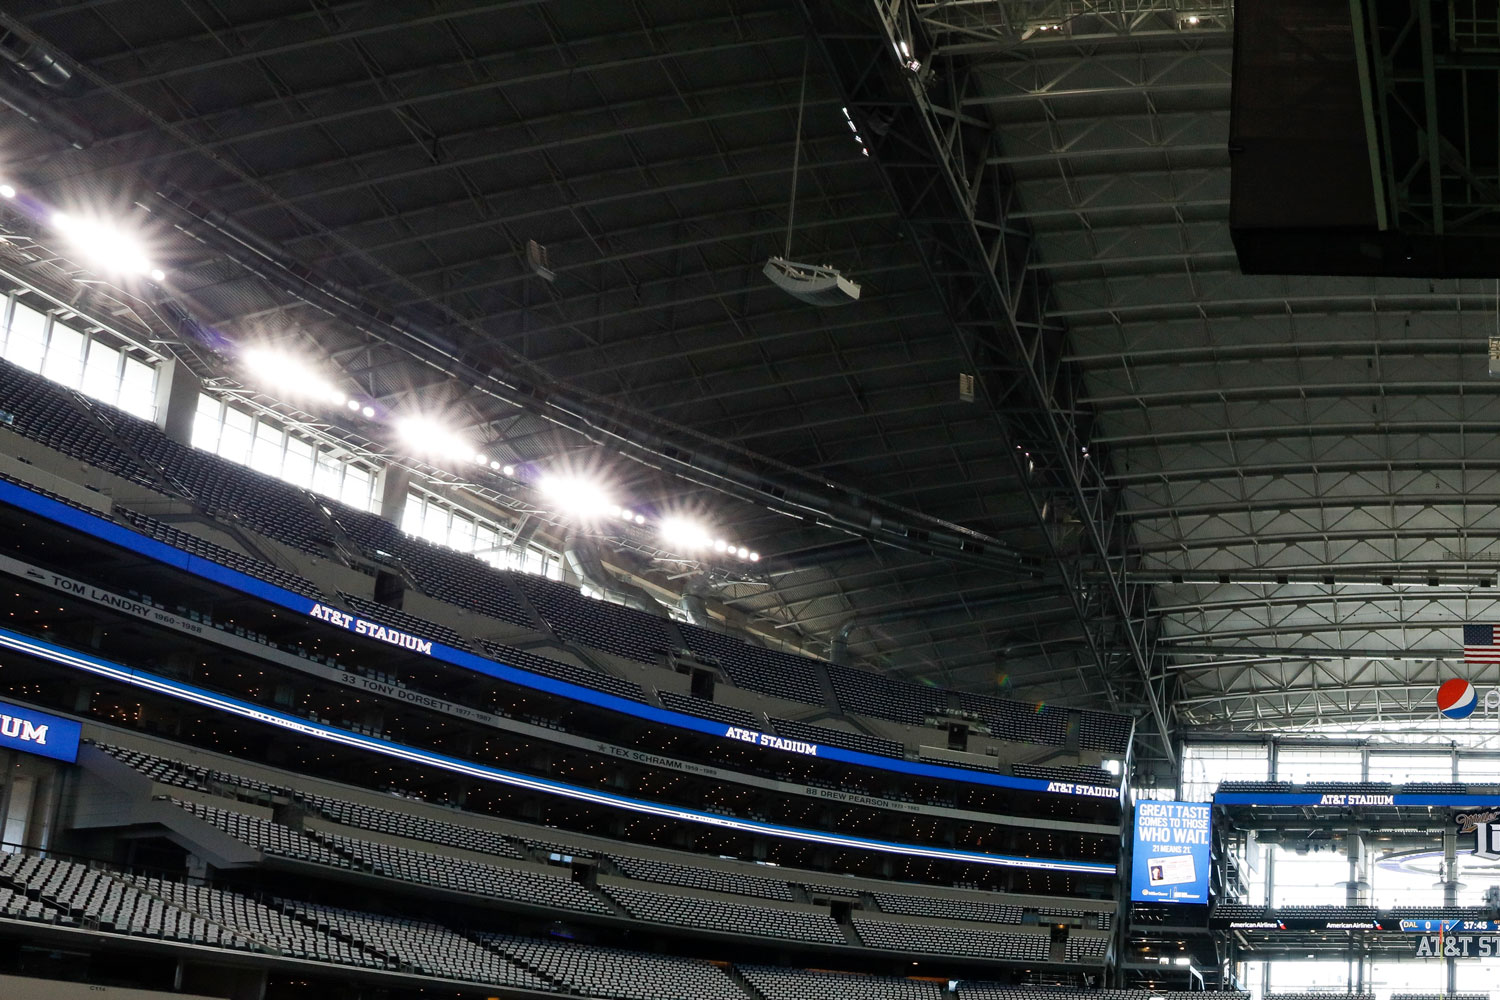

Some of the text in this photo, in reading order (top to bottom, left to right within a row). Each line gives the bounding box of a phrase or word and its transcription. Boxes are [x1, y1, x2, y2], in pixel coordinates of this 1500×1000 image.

[52, 575, 85, 595] TOM
[92, 589, 150, 617] LANDRY
[310, 603, 433, 655] AT&T STADIUM
[342, 673, 356, 684] 33
[362, 679, 395, 695] TONY
[398, 690, 452, 712] DORSETT
[0, 713, 48, 745] UM
[726, 727, 817, 756] AT&T STADIUM
[609, 746, 629, 757] TEX
[633, 752, 682, 769] SCHRAMM
[1047, 781, 1075, 793] AT&T
[806, 787, 817, 796] 88
[821, 790, 846, 801] DREW
[849, 795, 889, 808] PEARSON
[1320, 795, 1394, 805] AT&T STADIUM
[1140, 803, 1209, 819] GREAT TASTE
[1455, 811, 1500, 831] Miller
[1139, 816, 1208, 829] COMES TO THOSE
[1139, 827, 1208, 845] WHO WAIT.
[1160, 845, 1182, 853] MEANS
[1425, 921, 1431, 929] 0
[1464, 921, 1487, 930] 37:45
[1416, 936, 1473, 957] AT&T
